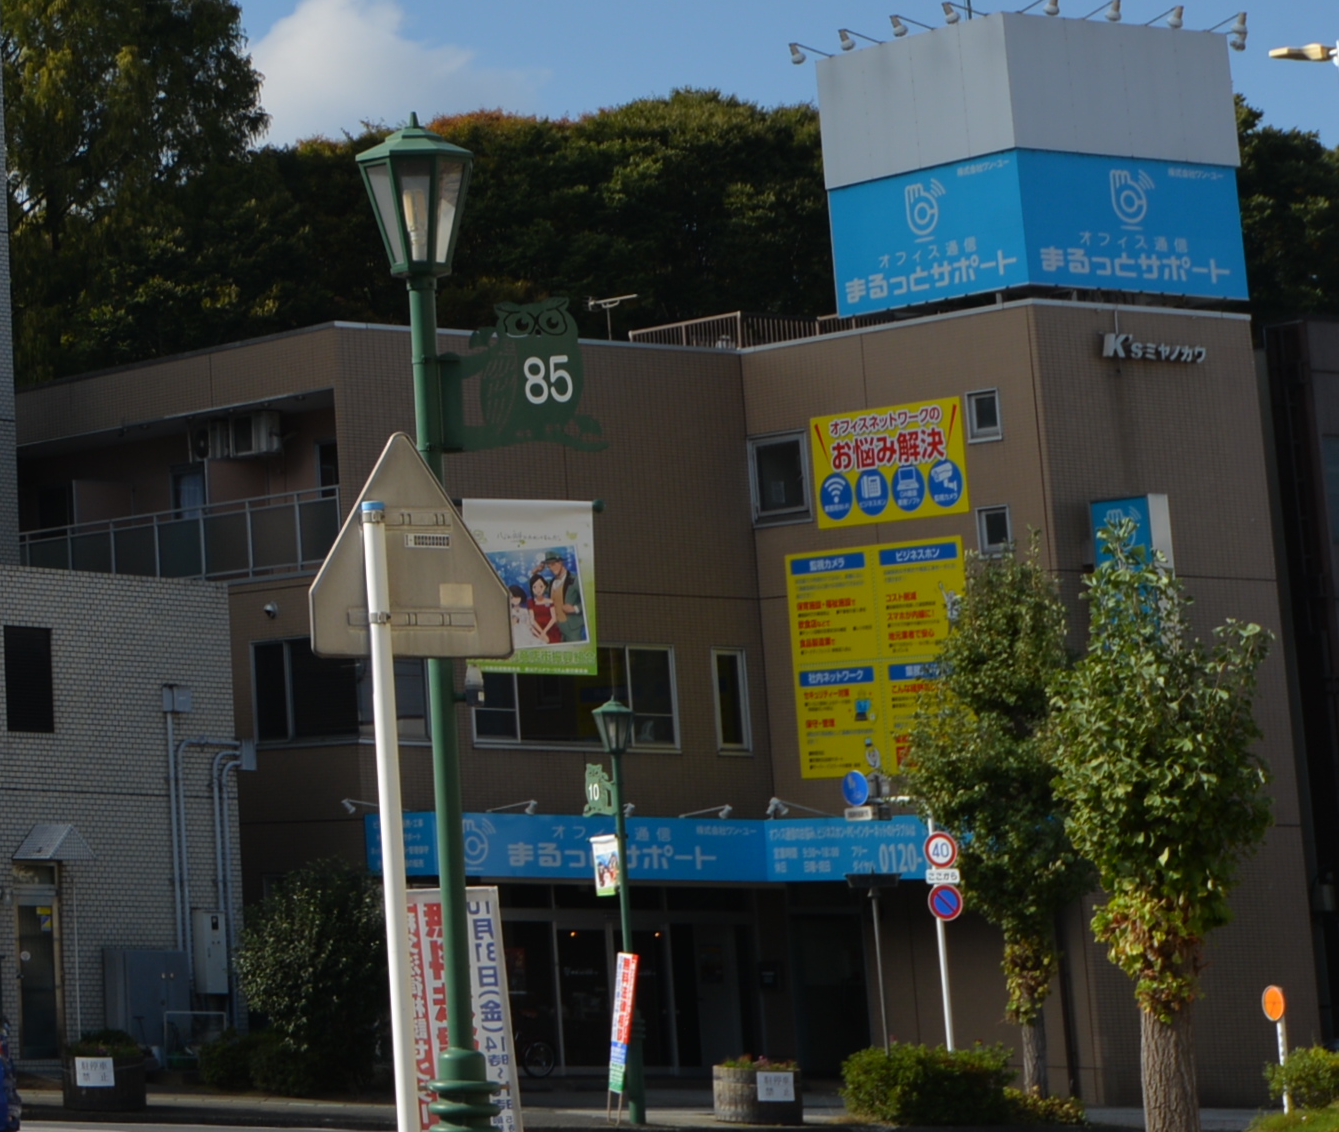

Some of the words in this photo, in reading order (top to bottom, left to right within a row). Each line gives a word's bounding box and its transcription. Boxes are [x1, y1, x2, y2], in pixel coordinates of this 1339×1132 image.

[878, 235, 977, 269] オフィス通信
[1078, 231, 1188, 254] オフィス通信
[845, 249, 1017, 304] まるっとサポート
[1040, 246, 1231, 285] まるっとサポート
[523, 354, 574, 404] 85
[829, 406, 941, 437] オフィスネットワークの
[831, 426, 946, 474] お悩み解決
[895, 548, 940, 562] ビジネスホン
[588, 783, 600, 800] 10
[552, 824, 672, 841] オフィ通信
[507, 842, 717, 870] まるっサポート
[932, 843, 950, 858] 40
[927, 871, 958, 881] ここから
